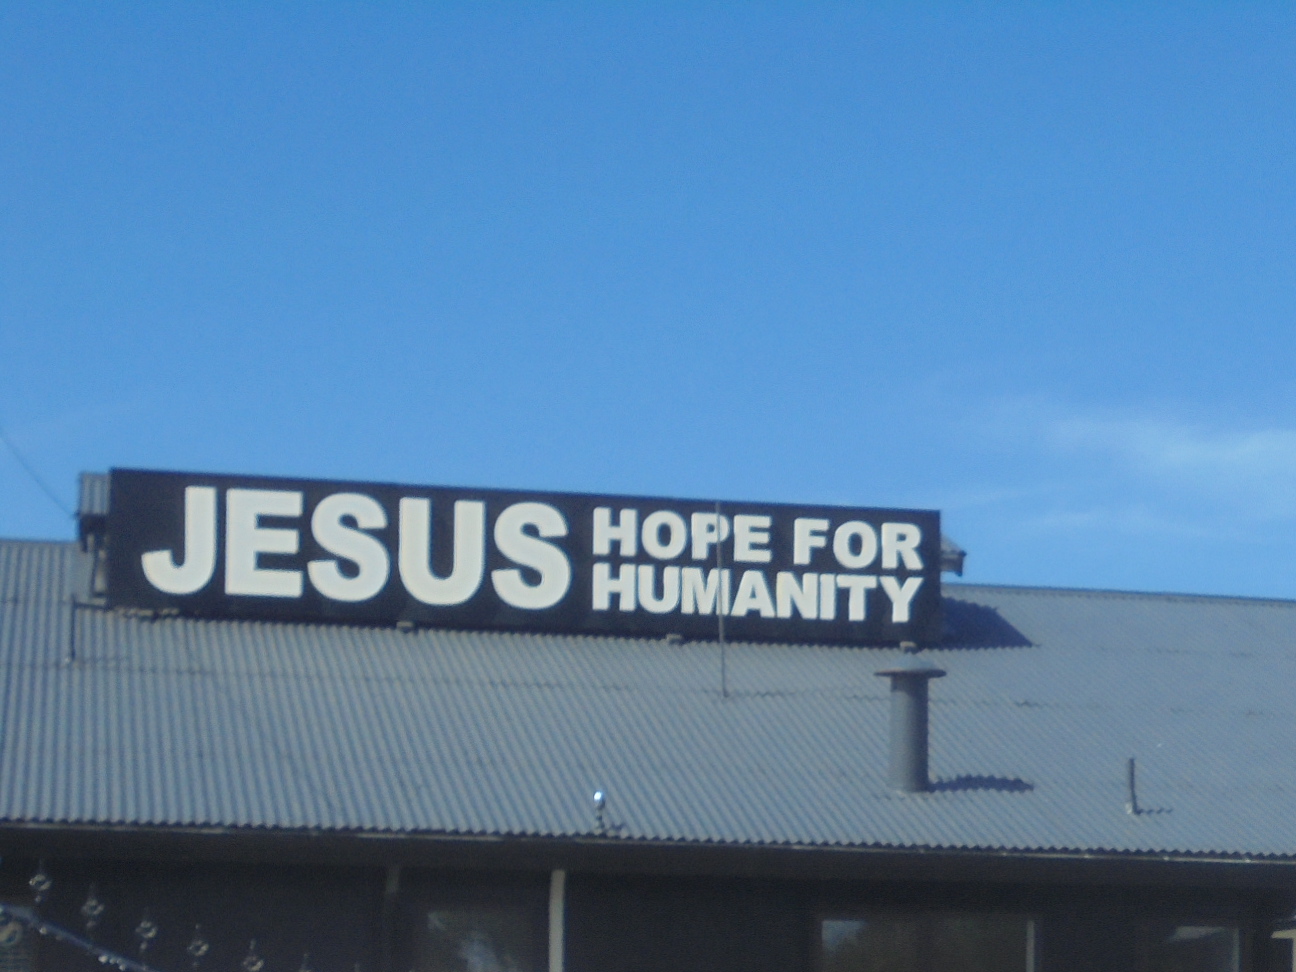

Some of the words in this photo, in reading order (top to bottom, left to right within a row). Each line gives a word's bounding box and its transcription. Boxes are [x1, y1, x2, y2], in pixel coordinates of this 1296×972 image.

[141, 485, 571, 610] JESUS
[592, 506, 772, 563] HOPE
[793, 517, 923, 571] FOR
[592, 562, 923, 623] HUMANITY
